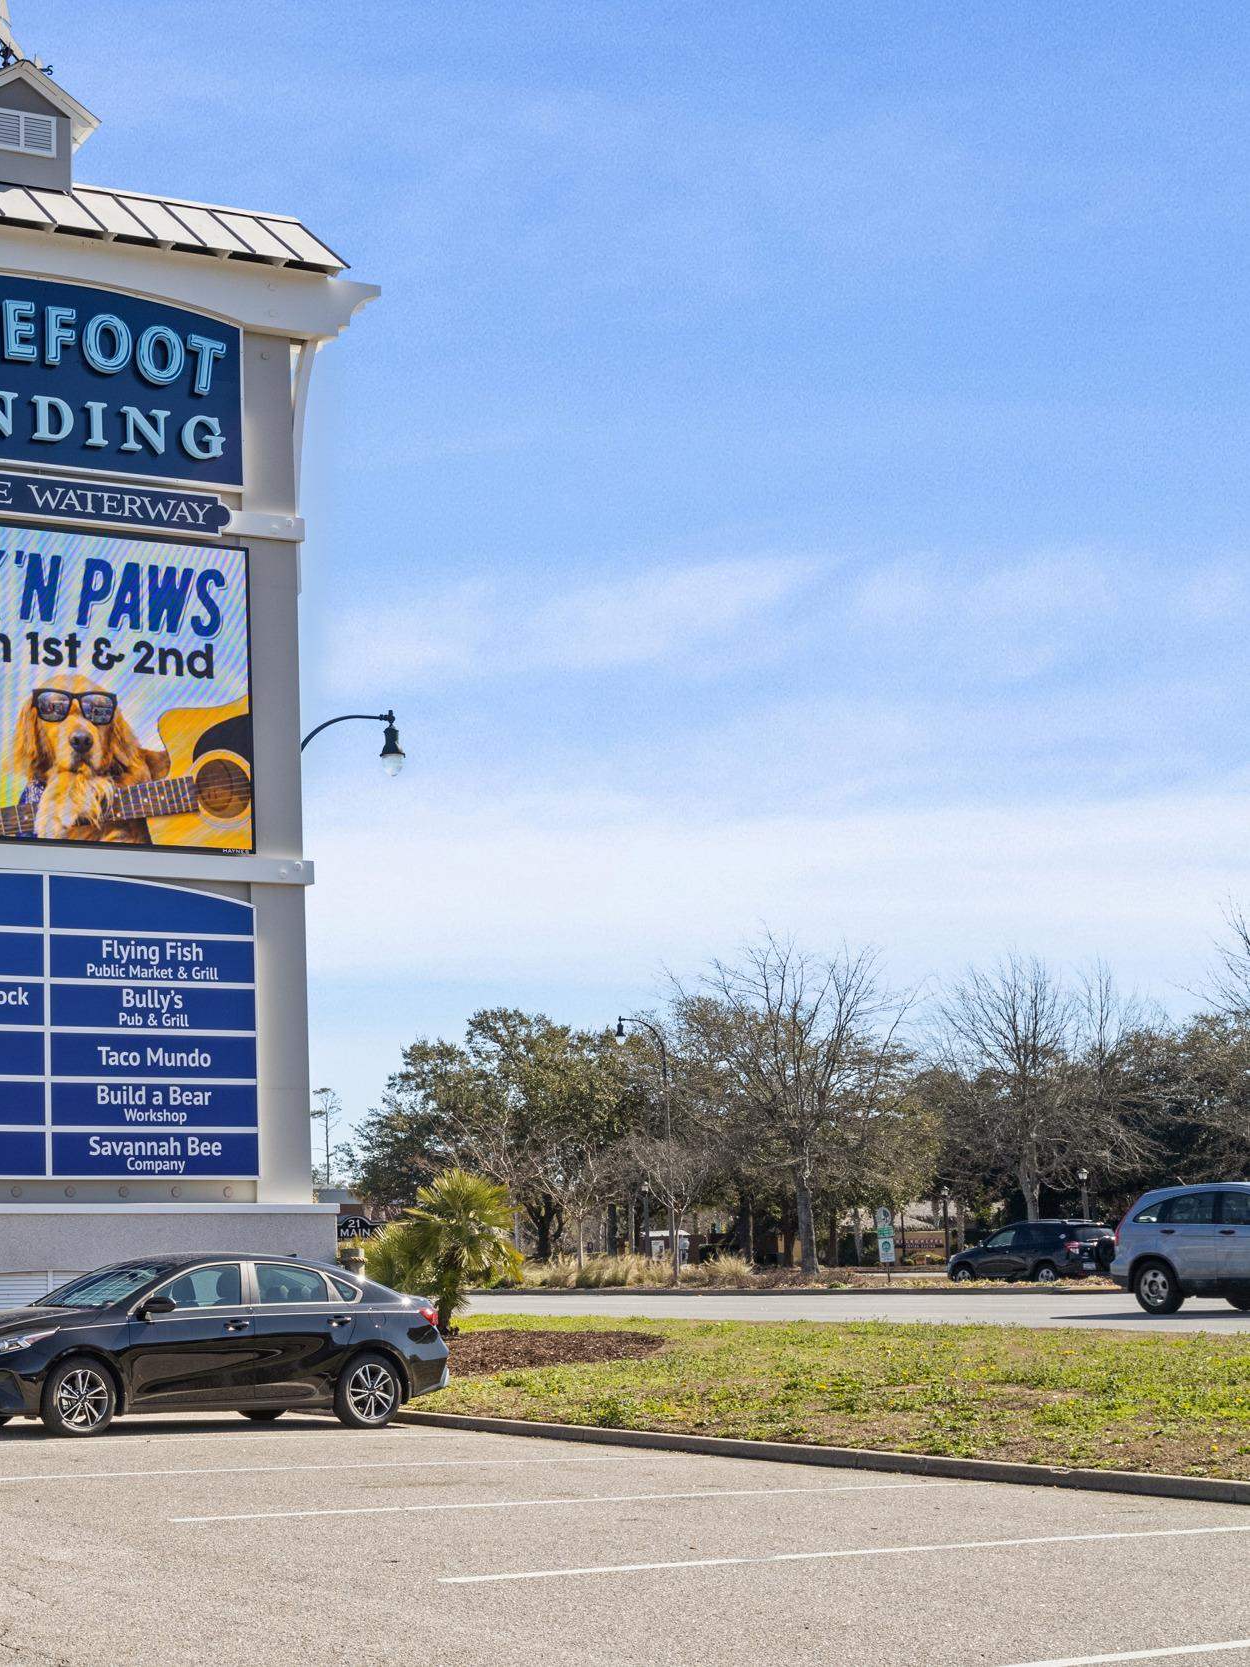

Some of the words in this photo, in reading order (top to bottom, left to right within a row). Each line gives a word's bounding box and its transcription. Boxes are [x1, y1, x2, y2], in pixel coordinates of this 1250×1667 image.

[28, 484, 213, 525] WATERWAY
[76, 557, 228, 640] PAWS
[26, 631, 81, 668] 1st
[91, 636, 125, 671] &
[133, 640, 215, 679] 2nd
[103, 940, 159, 963] Flying
[166, 942, 203, 961] Fish
[87, 964, 125, 977] Public
[130, 964, 173, 978] Market
[178, 967, 187, 979] &
[192, 967, 218, 980] Grill
[123, 989, 182, 1012] Bully's
[119, 1013, 142, 1025] Pub
[148, 1013, 157, 1026] &
[162, 1014, 189, 1027] Grill
[98, 1047, 140, 1066] Taco
[147, 1048, 211, 1067] Mundo
[97, 1085, 146, 1104] Build
[153, 1091, 162, 1105] a
[170, 1086, 211, 1105] Bear
[124, 1109, 187, 1124] Workshop
[90, 1136, 180, 1155] Savannah
[188, 1138, 221, 1156] Bee
[127, 1157, 185, 1173] Company
[340, 1228, 371, 1237] MAIN
[348, 1219, 361, 1228] 21
